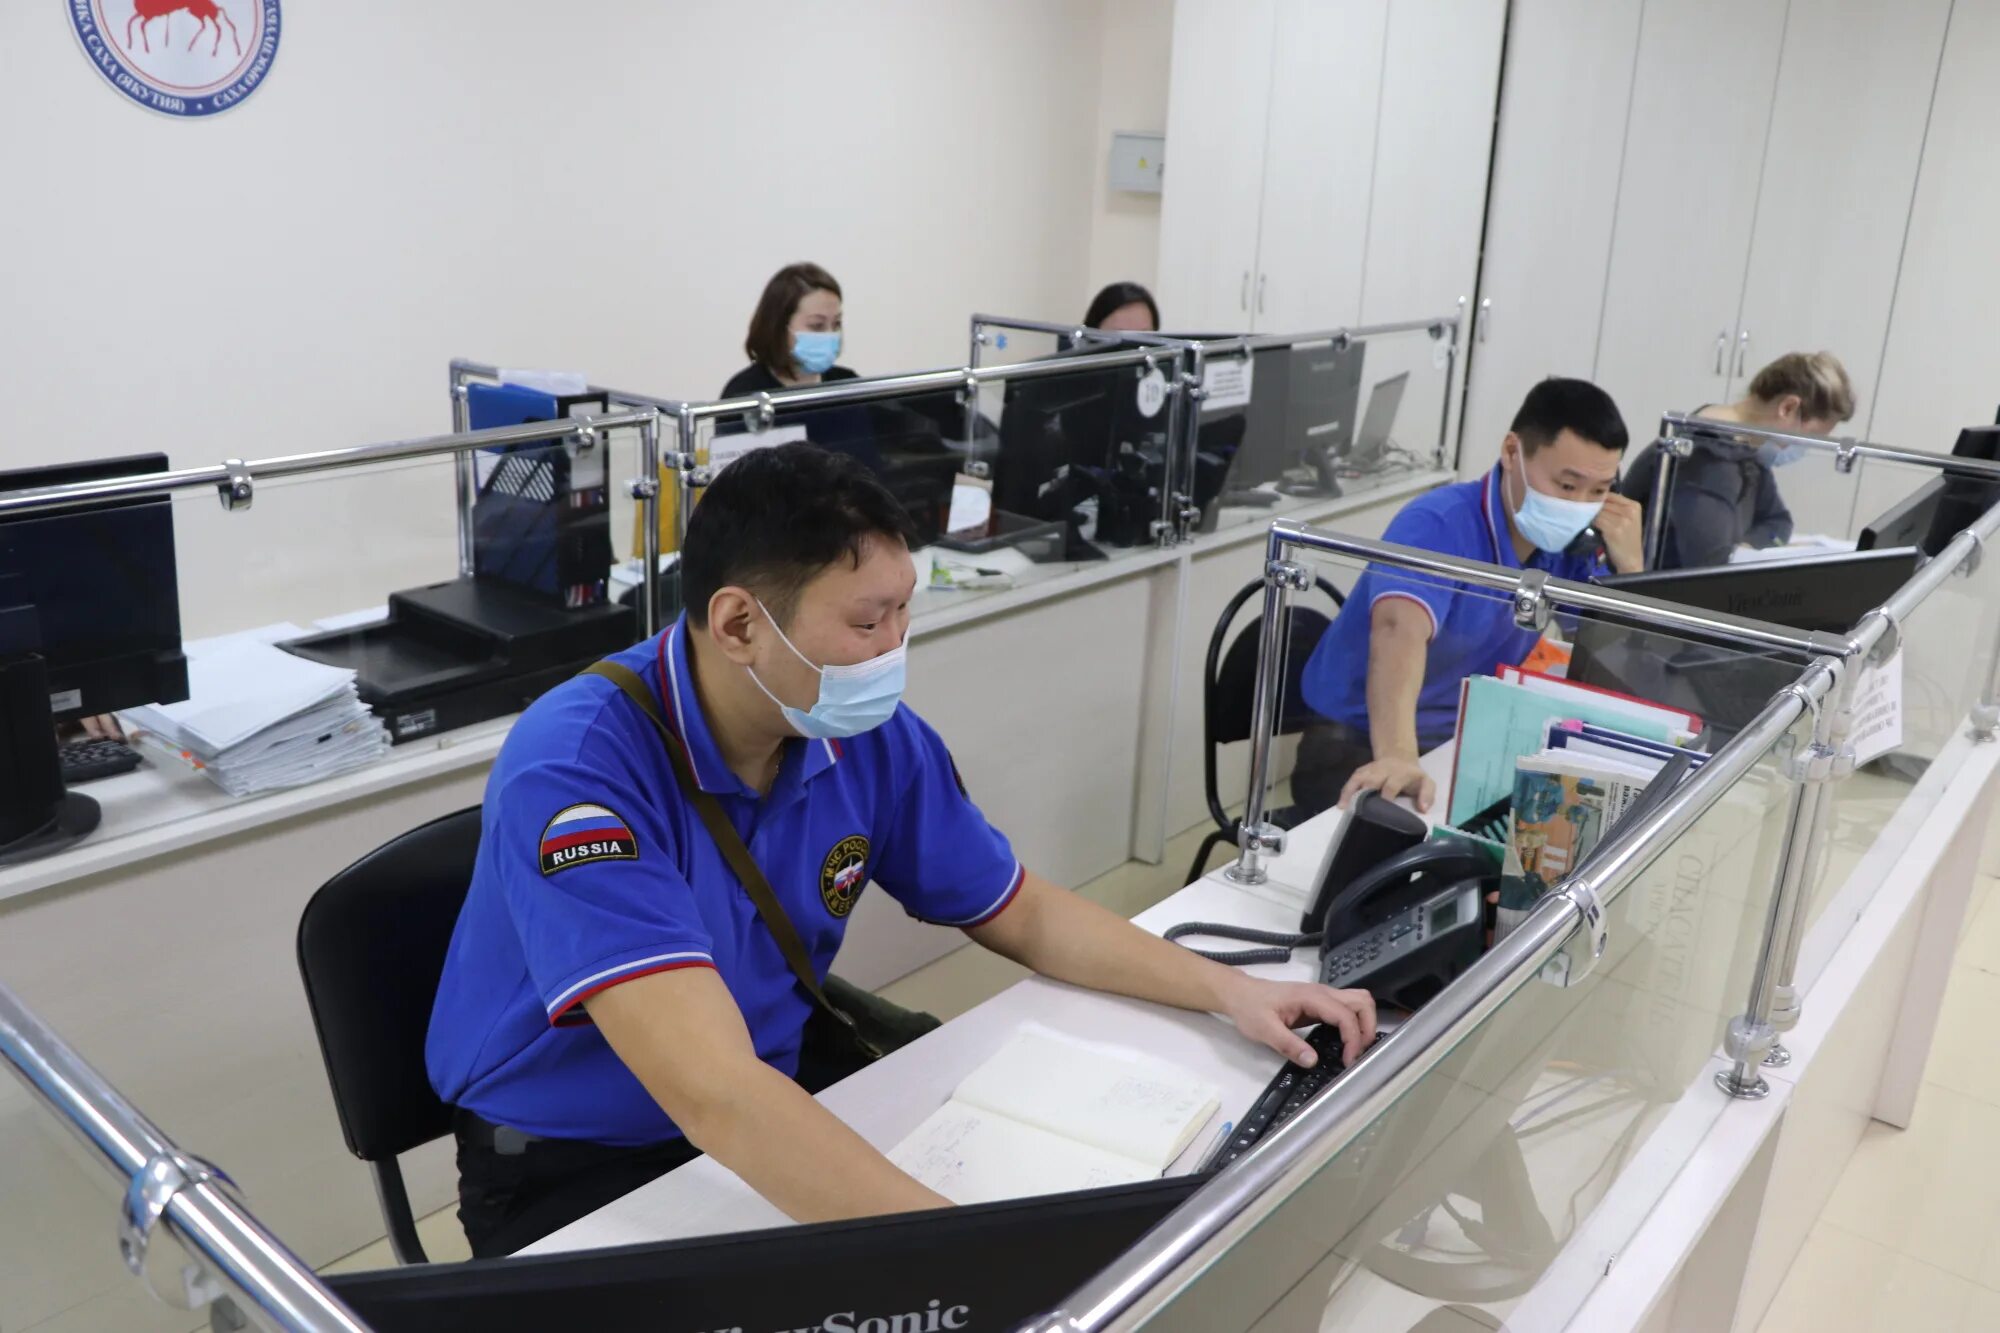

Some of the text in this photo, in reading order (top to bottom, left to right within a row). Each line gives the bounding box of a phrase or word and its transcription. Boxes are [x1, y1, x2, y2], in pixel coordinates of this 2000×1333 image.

[87, 34, 118, 76] САХА
[115, 72, 186, 113] (ЯКУТИЯ)
[213, 84, 248, 109] САХА
[553, 841, 622, 865] RUSSIA
[824, 850, 843, 877] МЧС
